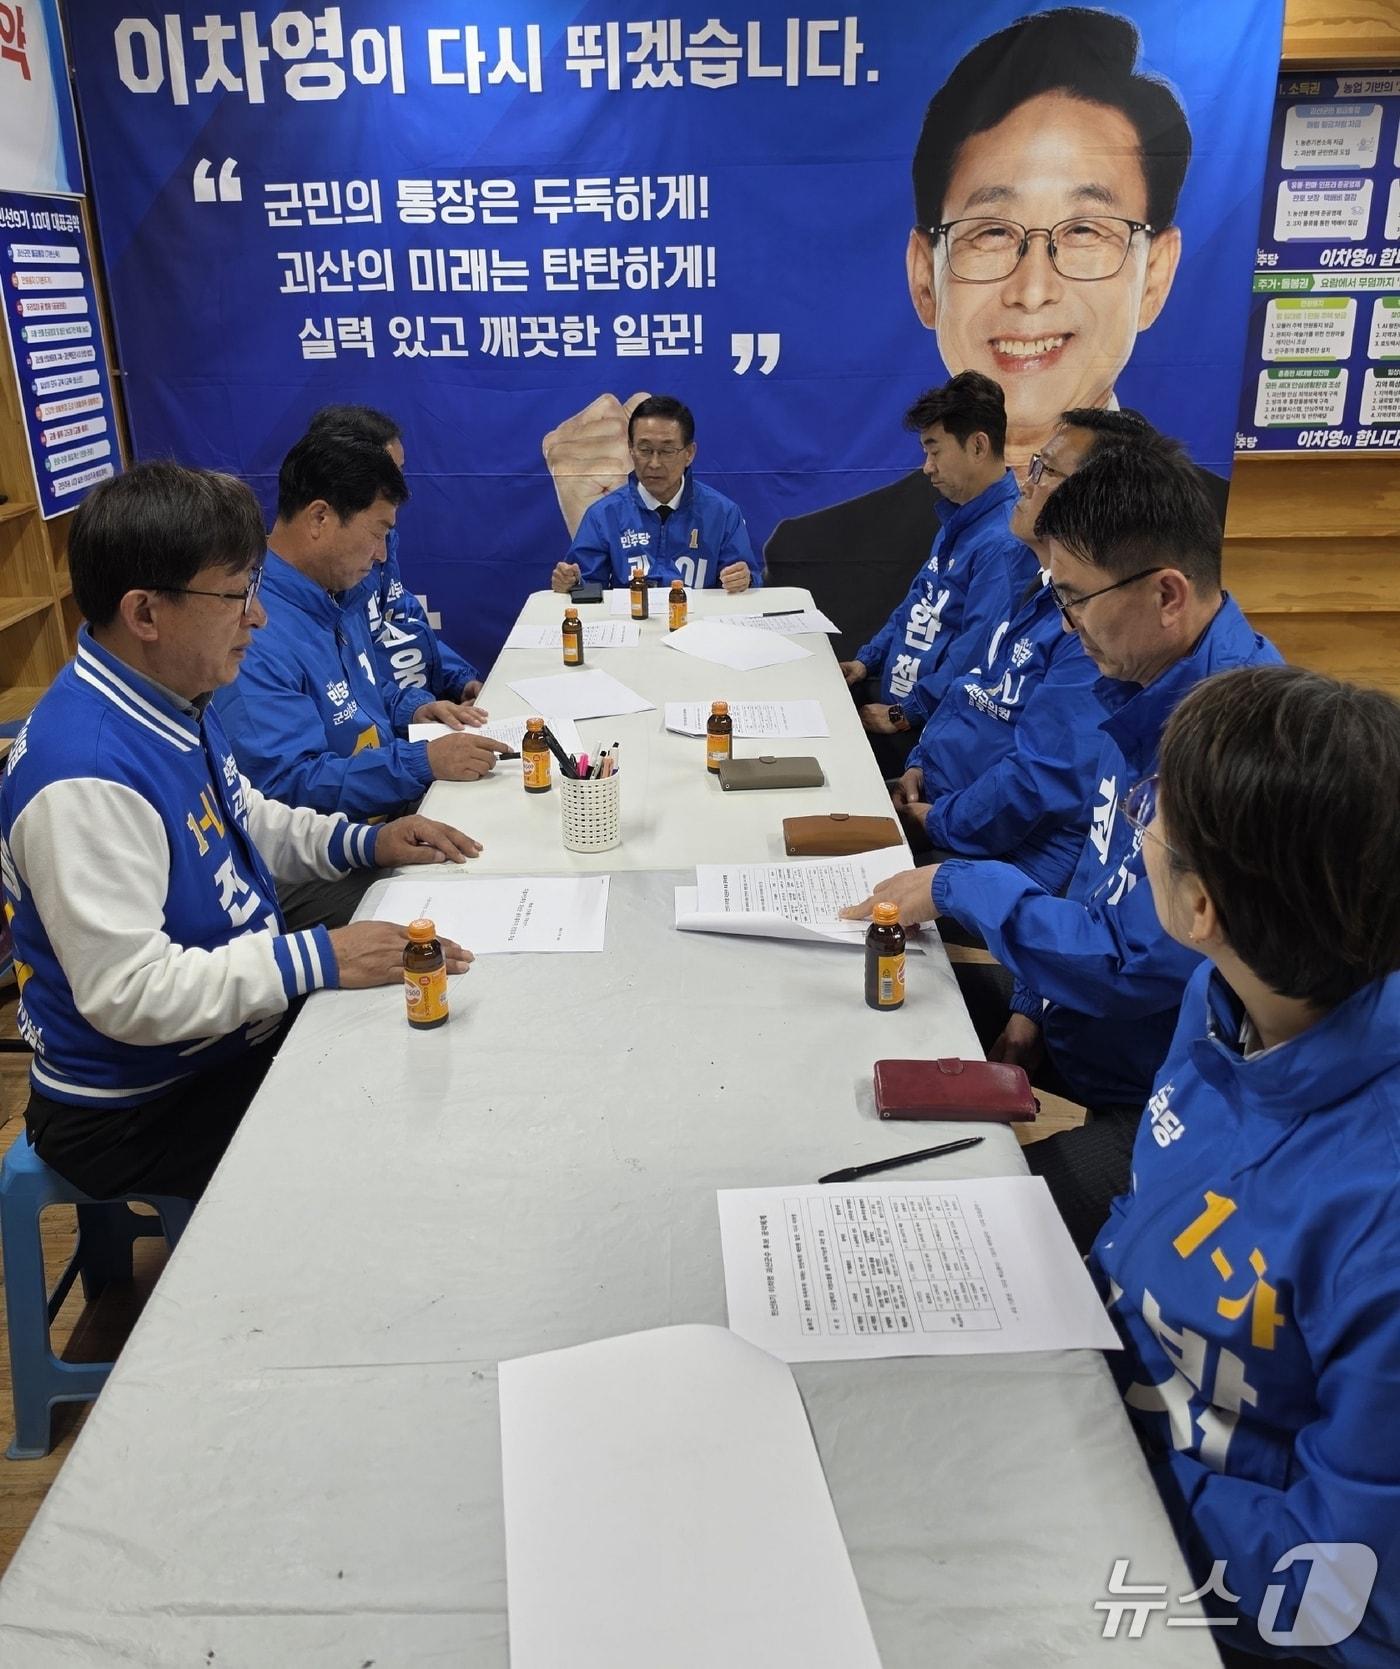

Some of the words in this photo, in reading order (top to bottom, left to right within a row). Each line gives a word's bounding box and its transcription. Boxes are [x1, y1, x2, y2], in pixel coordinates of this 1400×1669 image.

[115, 7, 404, 106] 이차영이
[428, 25, 543, 94] 다시
[566, 16, 879, 90] 뛰겠습니다.
[1344, 81, 1363, 94] 농업
[1364, 80, 1393, 93] 기반의
[264, 179, 382, 227] 군민의
[396, 179, 520, 224] 통장은
[534, 175, 709, 223] 두둑하게!
[1257, 252, 1279, 266] 주당
[1320, 248, 1376, 267] 이차영이
[277, 249, 395, 294] 괴산의
[408, 248, 530, 292] 미래는
[542, 244, 716, 291] 탄탄하게!
[1320, 278, 1358, 289] 요람에서
[1358, 277, 1396, 288] 무덤까지
[299, 317, 375, 360] 실력
[389, 316, 469, 358] 있고
[480, 315, 601, 358] 깨끗한
[613, 313, 703, 357] 일꾼!
[1235, 436, 1258, 449] 주당
[1297, 430, 1352, 448] 이차영이
[620, 532, 651, 549] 민주당
